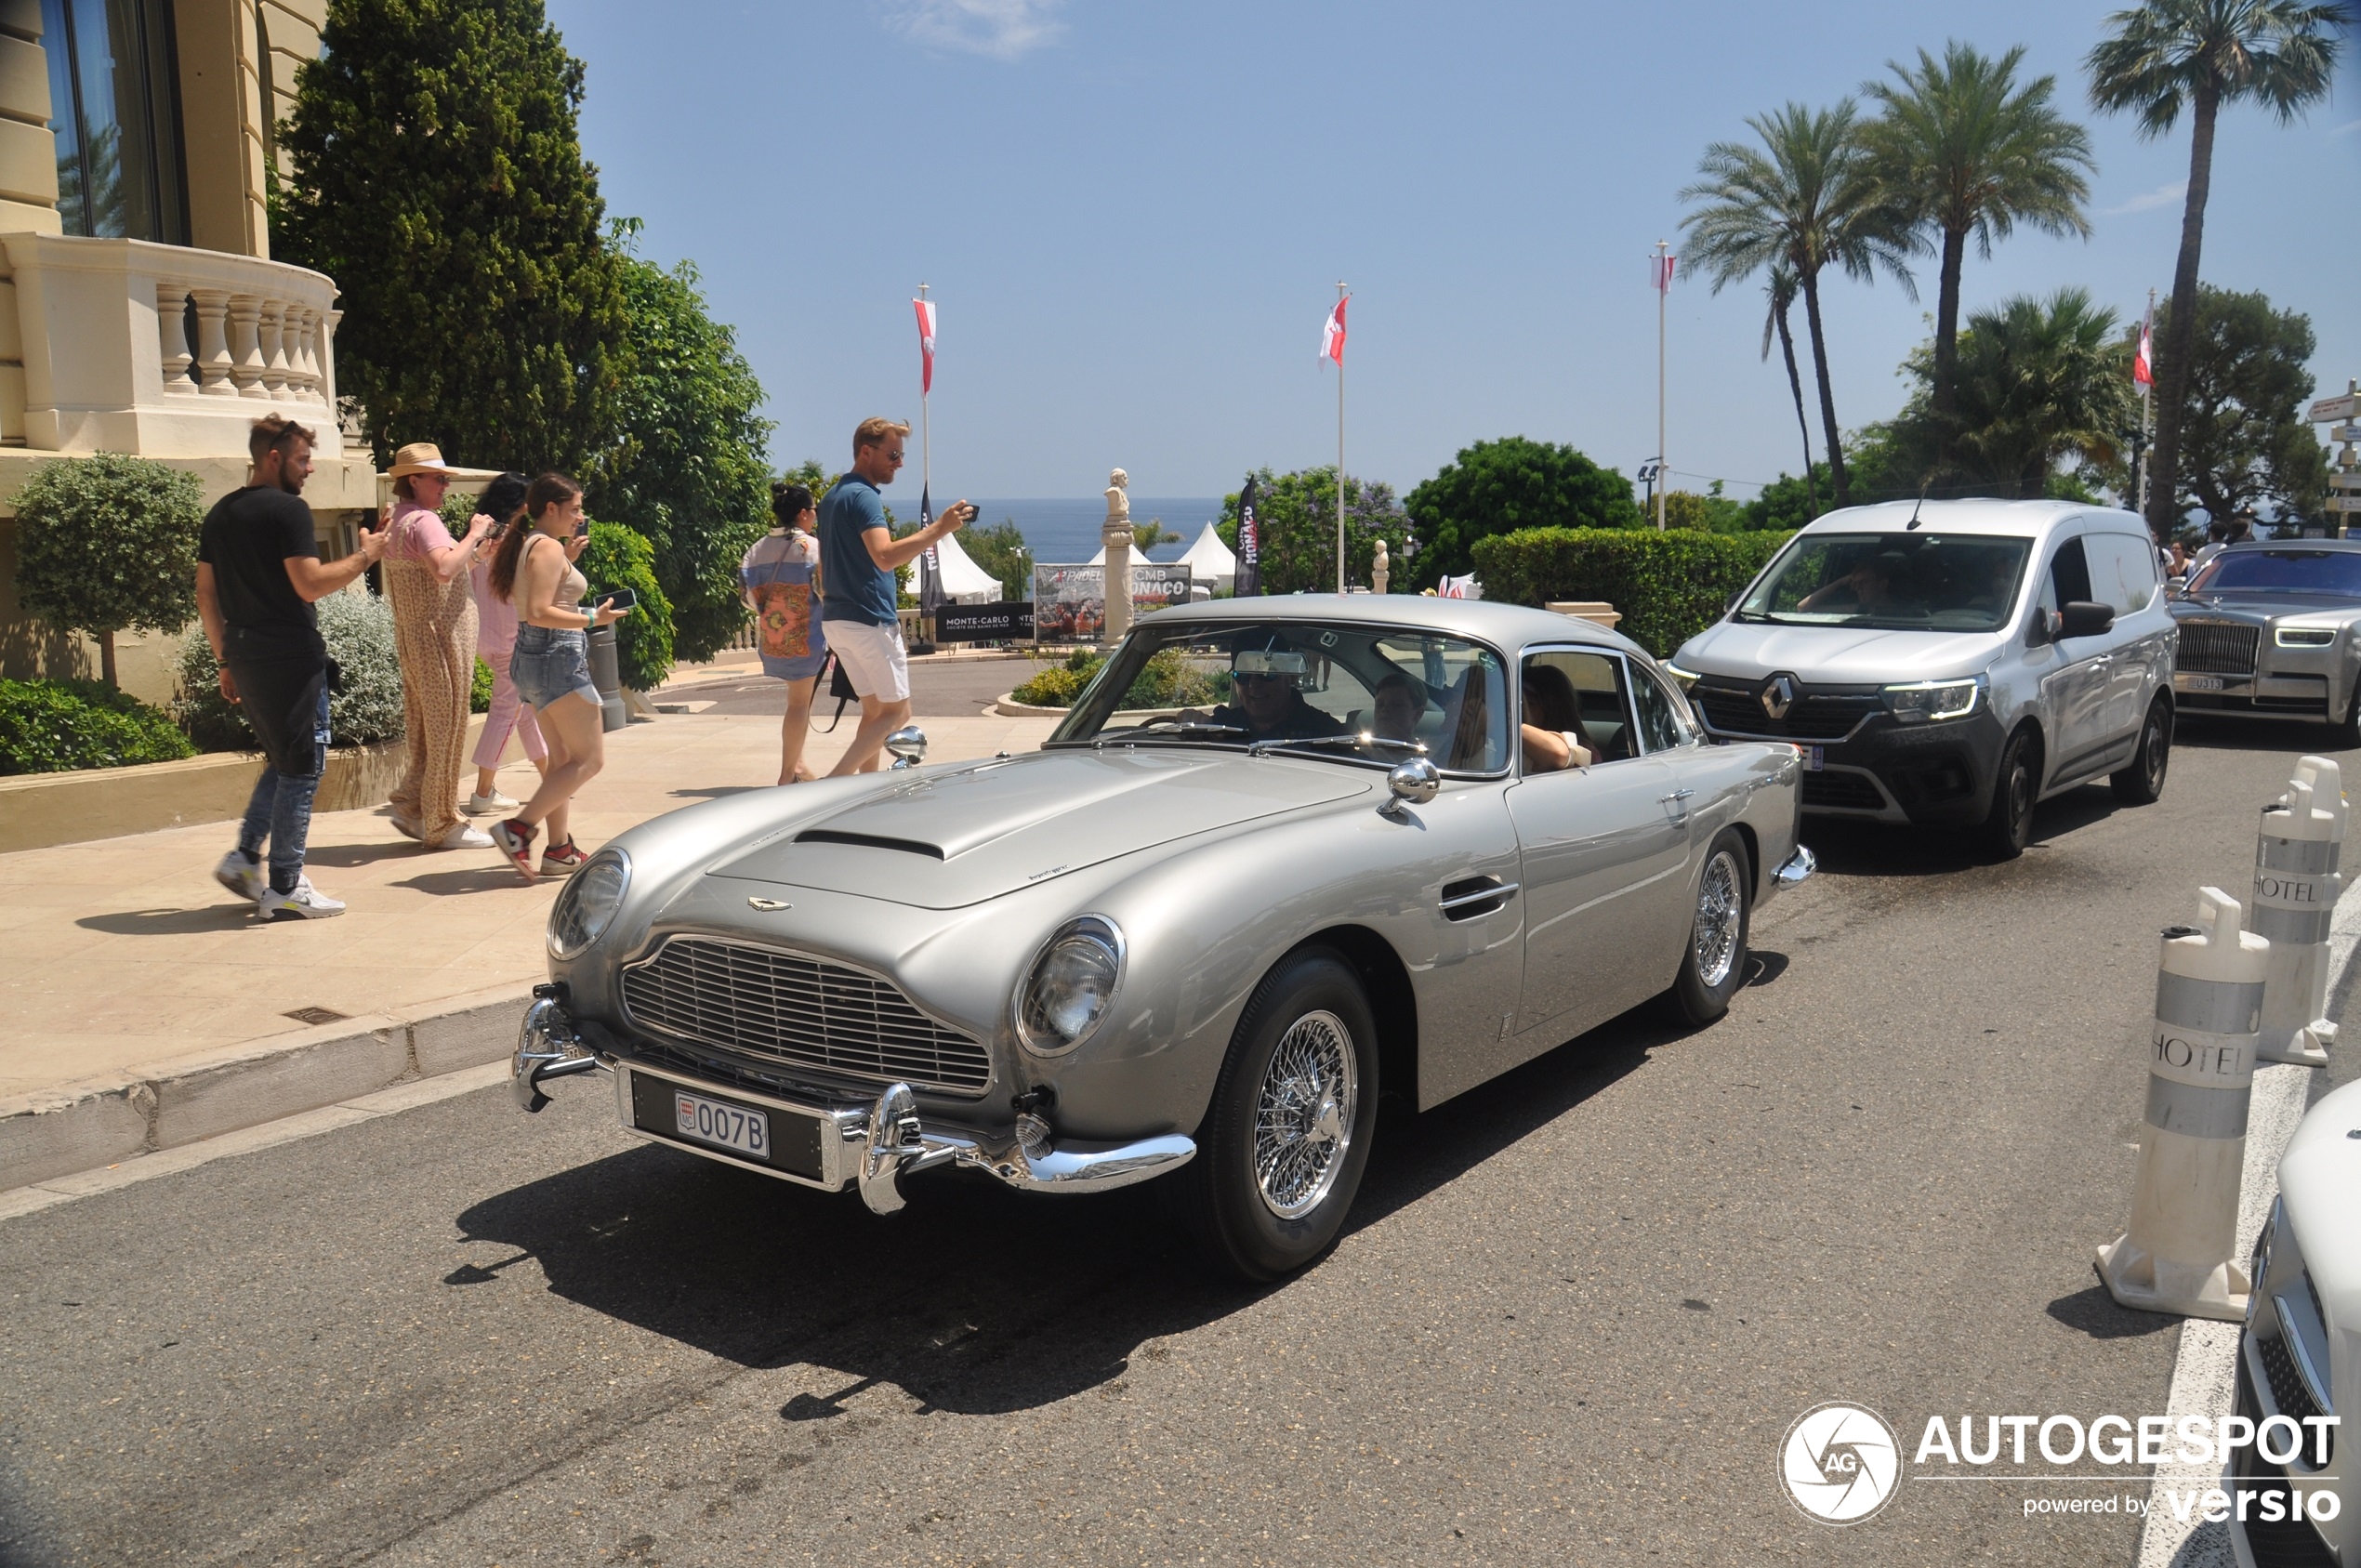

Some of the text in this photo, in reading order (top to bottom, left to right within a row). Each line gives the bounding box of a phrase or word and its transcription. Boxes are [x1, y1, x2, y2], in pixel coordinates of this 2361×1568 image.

[1067, 571, 1101, 582] PADEL
[1135, 570, 1167, 581] CMB
[1131, 581, 1184, 595] ONACO
[2196, 679, 2222, 689] U313
[1814, 758, 1822, 768] 06
[2254, 876, 2316, 903] HOTEL
[2151, 1034, 2247, 1075] HOTEL
[681, 1115, 692, 1126] MC
[698, 1103, 763, 1150] 007B
